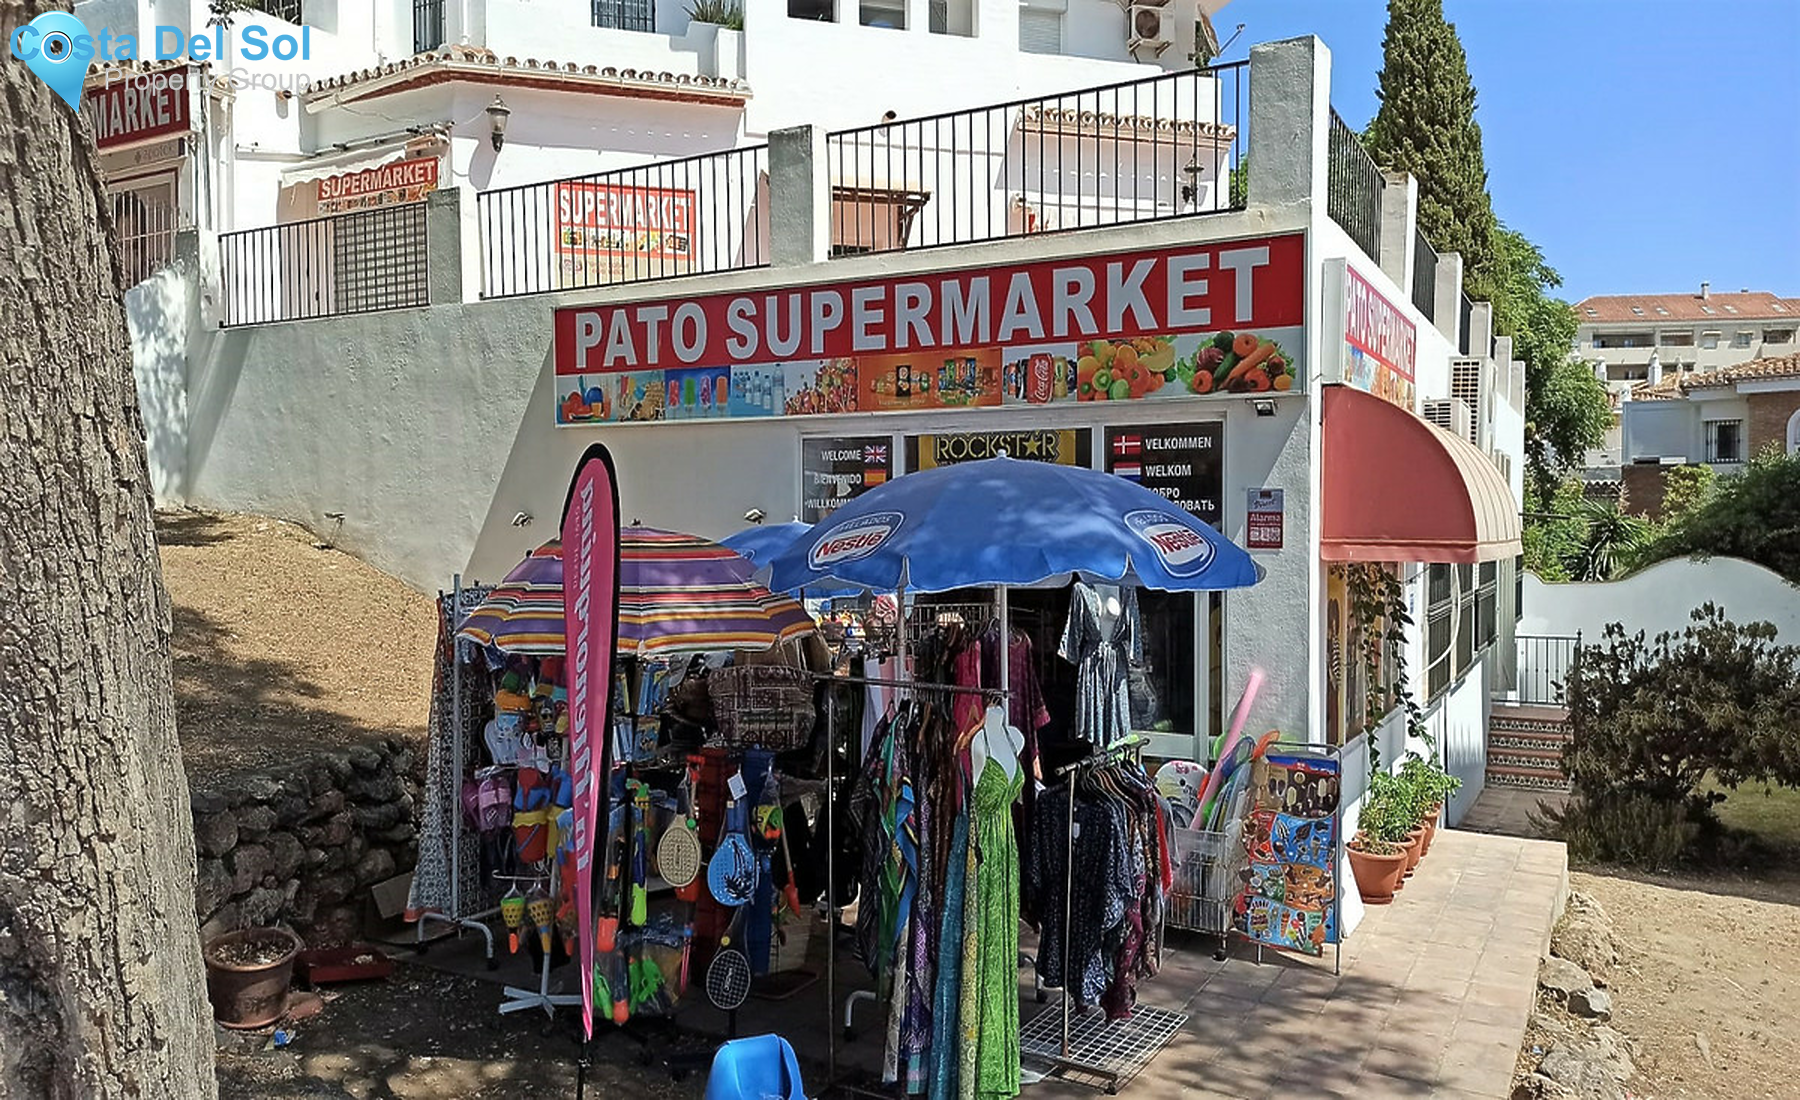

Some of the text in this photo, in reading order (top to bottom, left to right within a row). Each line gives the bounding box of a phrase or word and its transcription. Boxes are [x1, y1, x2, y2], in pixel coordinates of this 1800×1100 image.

[321, 161, 435, 198] SUPERMARKET
[560, 188, 692, 231] SUPERMARKET
[575, 246, 1270, 369] PATO SUPERMARKET
[1346, 271, 1367, 345] PATO
[821, 449, 862, 461] WELCOME
[1145, 437, 1212, 450] VELKOMMEN
[1145, 464, 1192, 477] WELKOM
